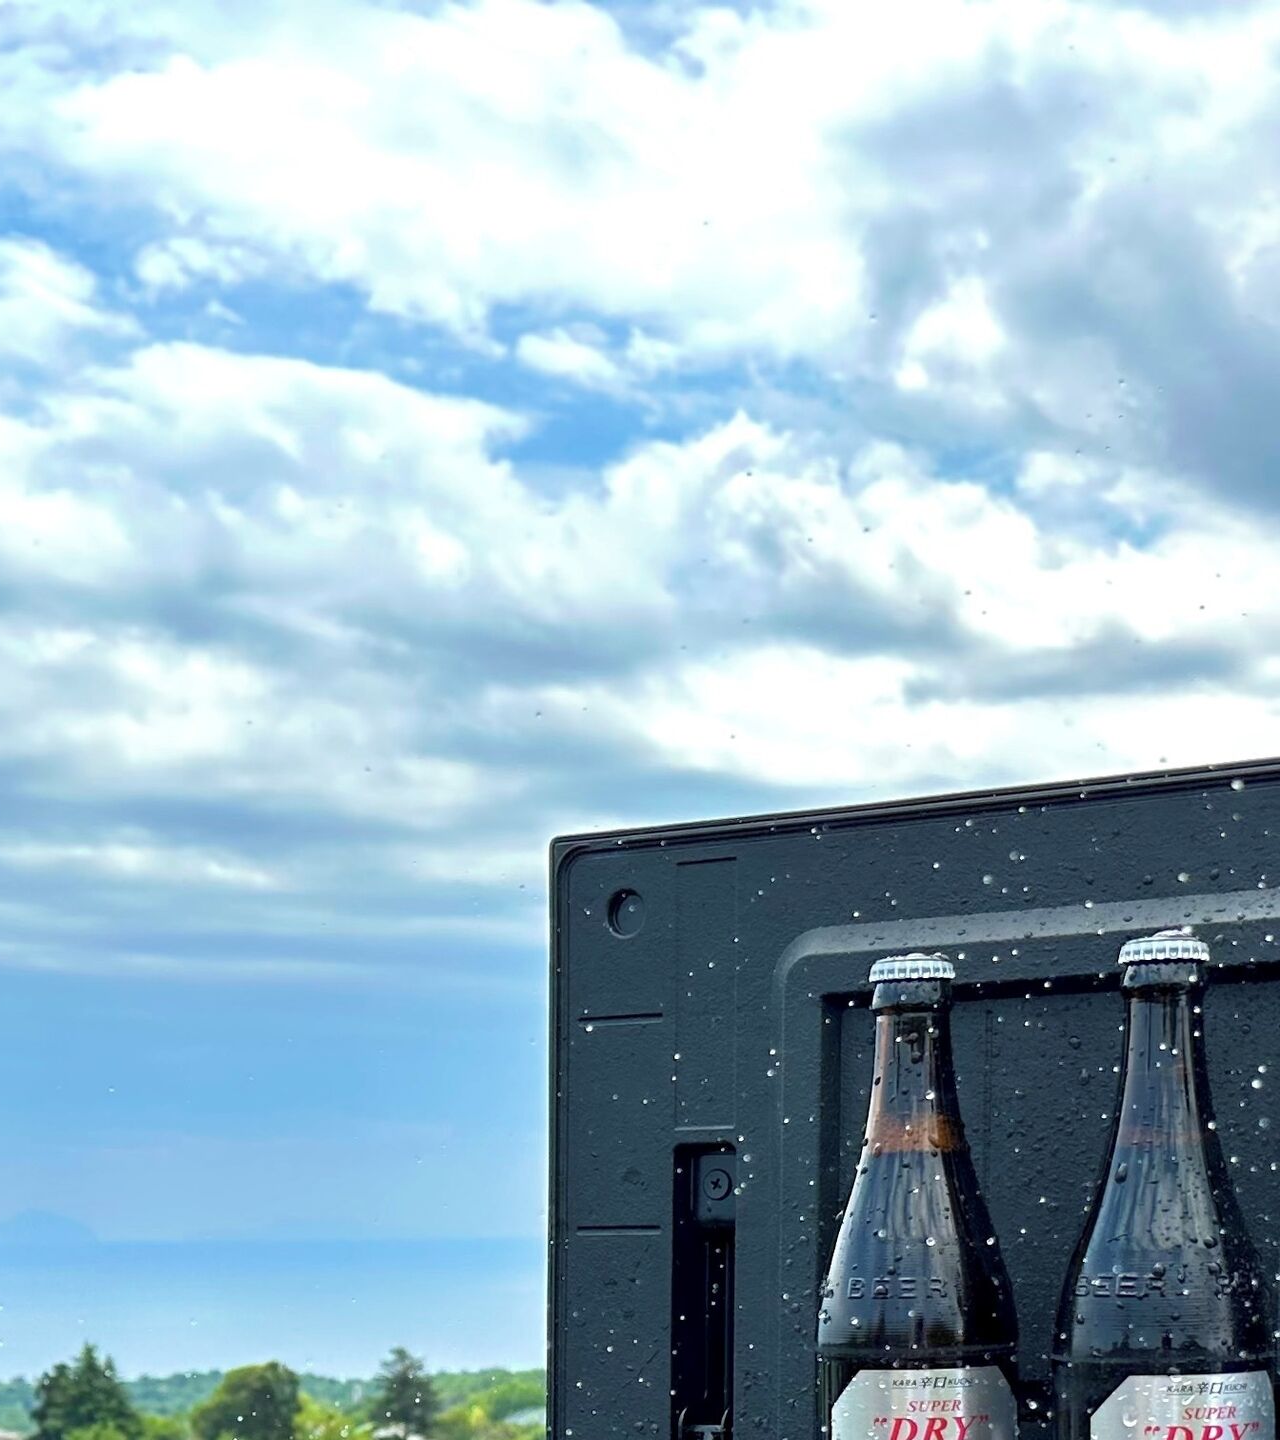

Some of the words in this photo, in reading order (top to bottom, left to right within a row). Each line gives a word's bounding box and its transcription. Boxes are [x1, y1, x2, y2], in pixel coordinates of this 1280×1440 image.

[892, 1379, 917, 1387] KARA
[907, 1399, 962, 1413] SUPER
[1182, 1406, 1237, 1420] SUPER
